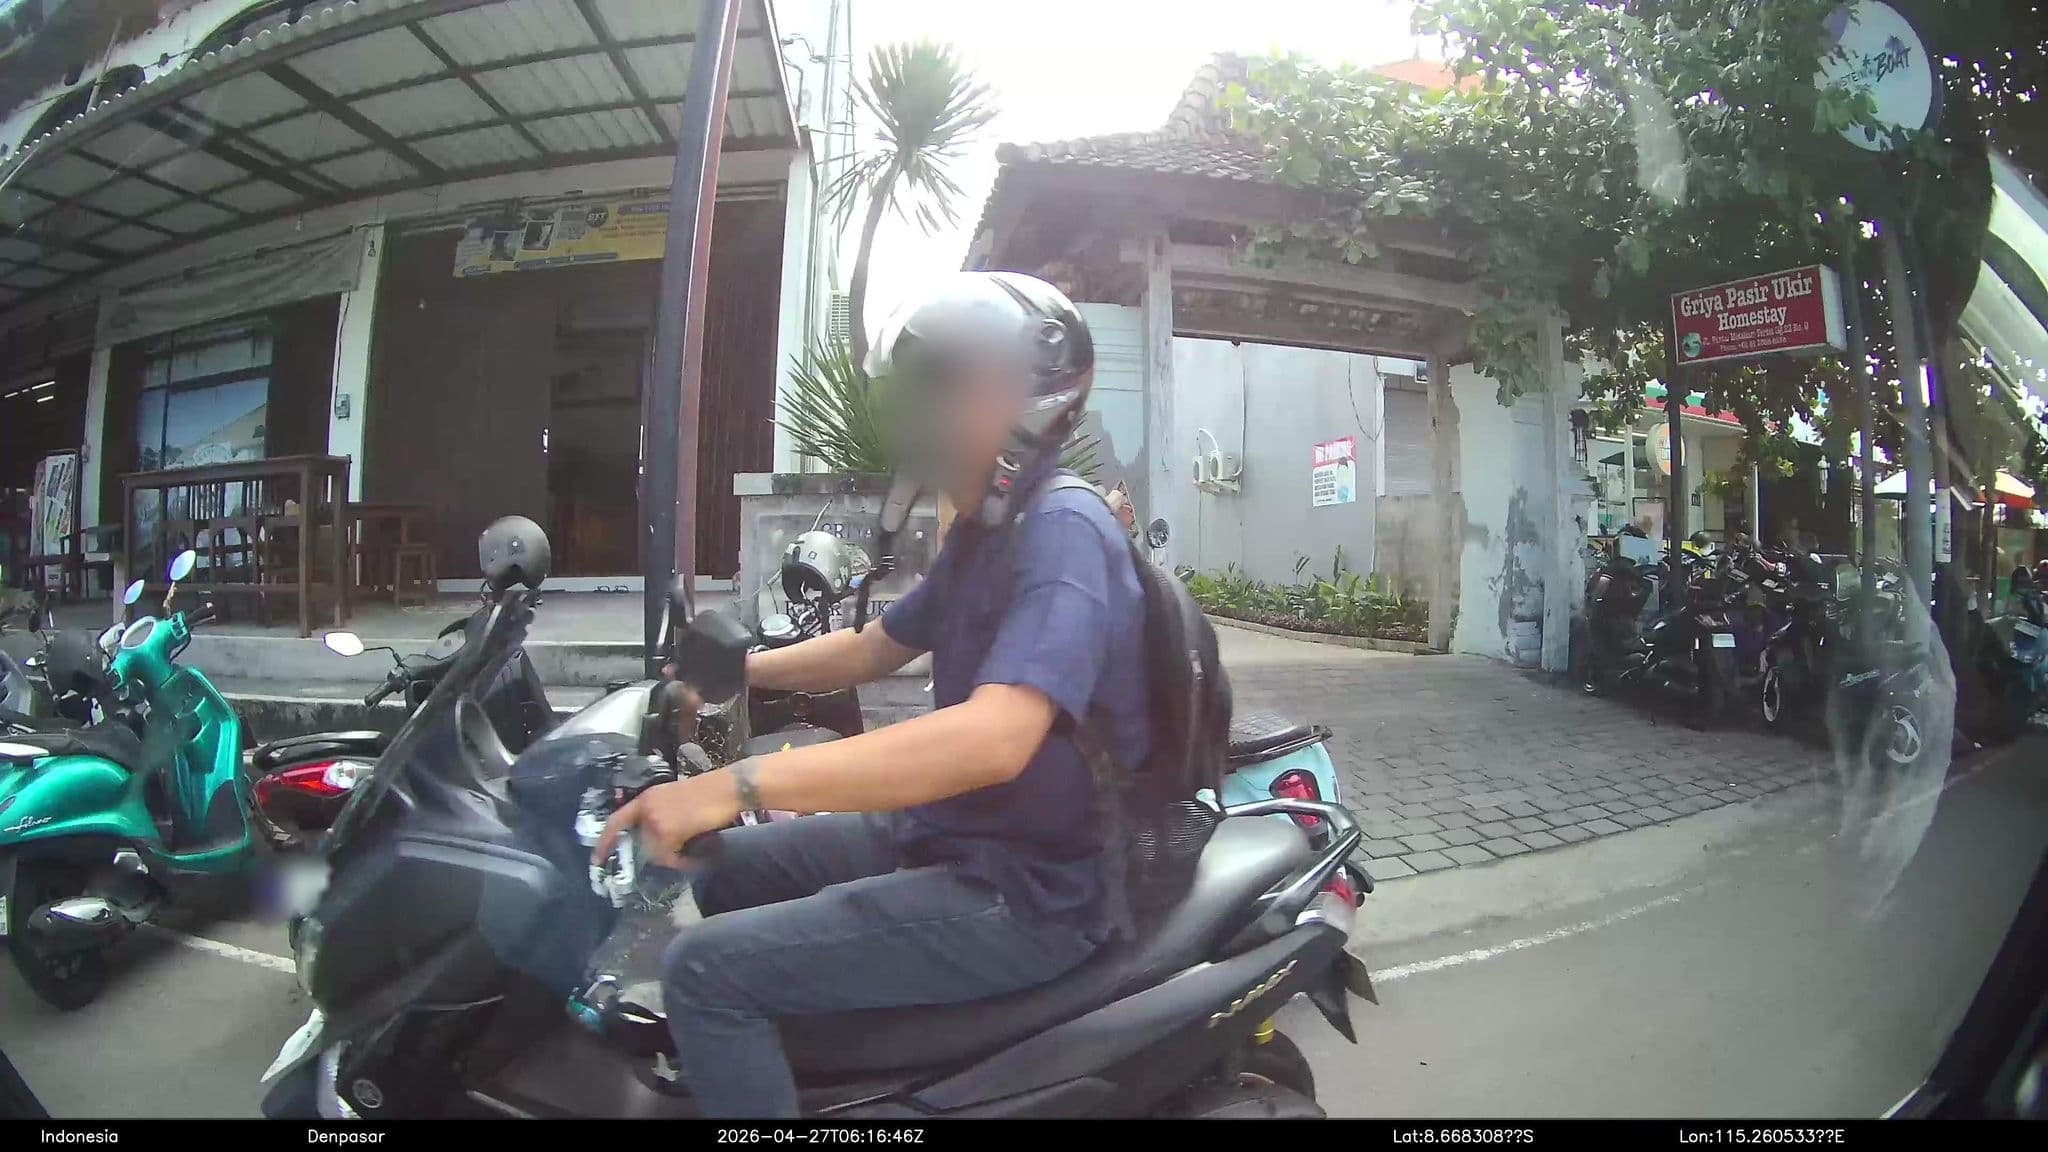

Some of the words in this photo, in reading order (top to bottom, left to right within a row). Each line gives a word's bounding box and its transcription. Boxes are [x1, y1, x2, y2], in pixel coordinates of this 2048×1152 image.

[1874, 47, 1911, 82] BOAT
[1681, 293, 1723, 319] Griya
[1725, 281, 1769, 309] Pasir
[1771, 272, 1812, 300] Ukir
[1718, 304, 1787, 331] Homestay
